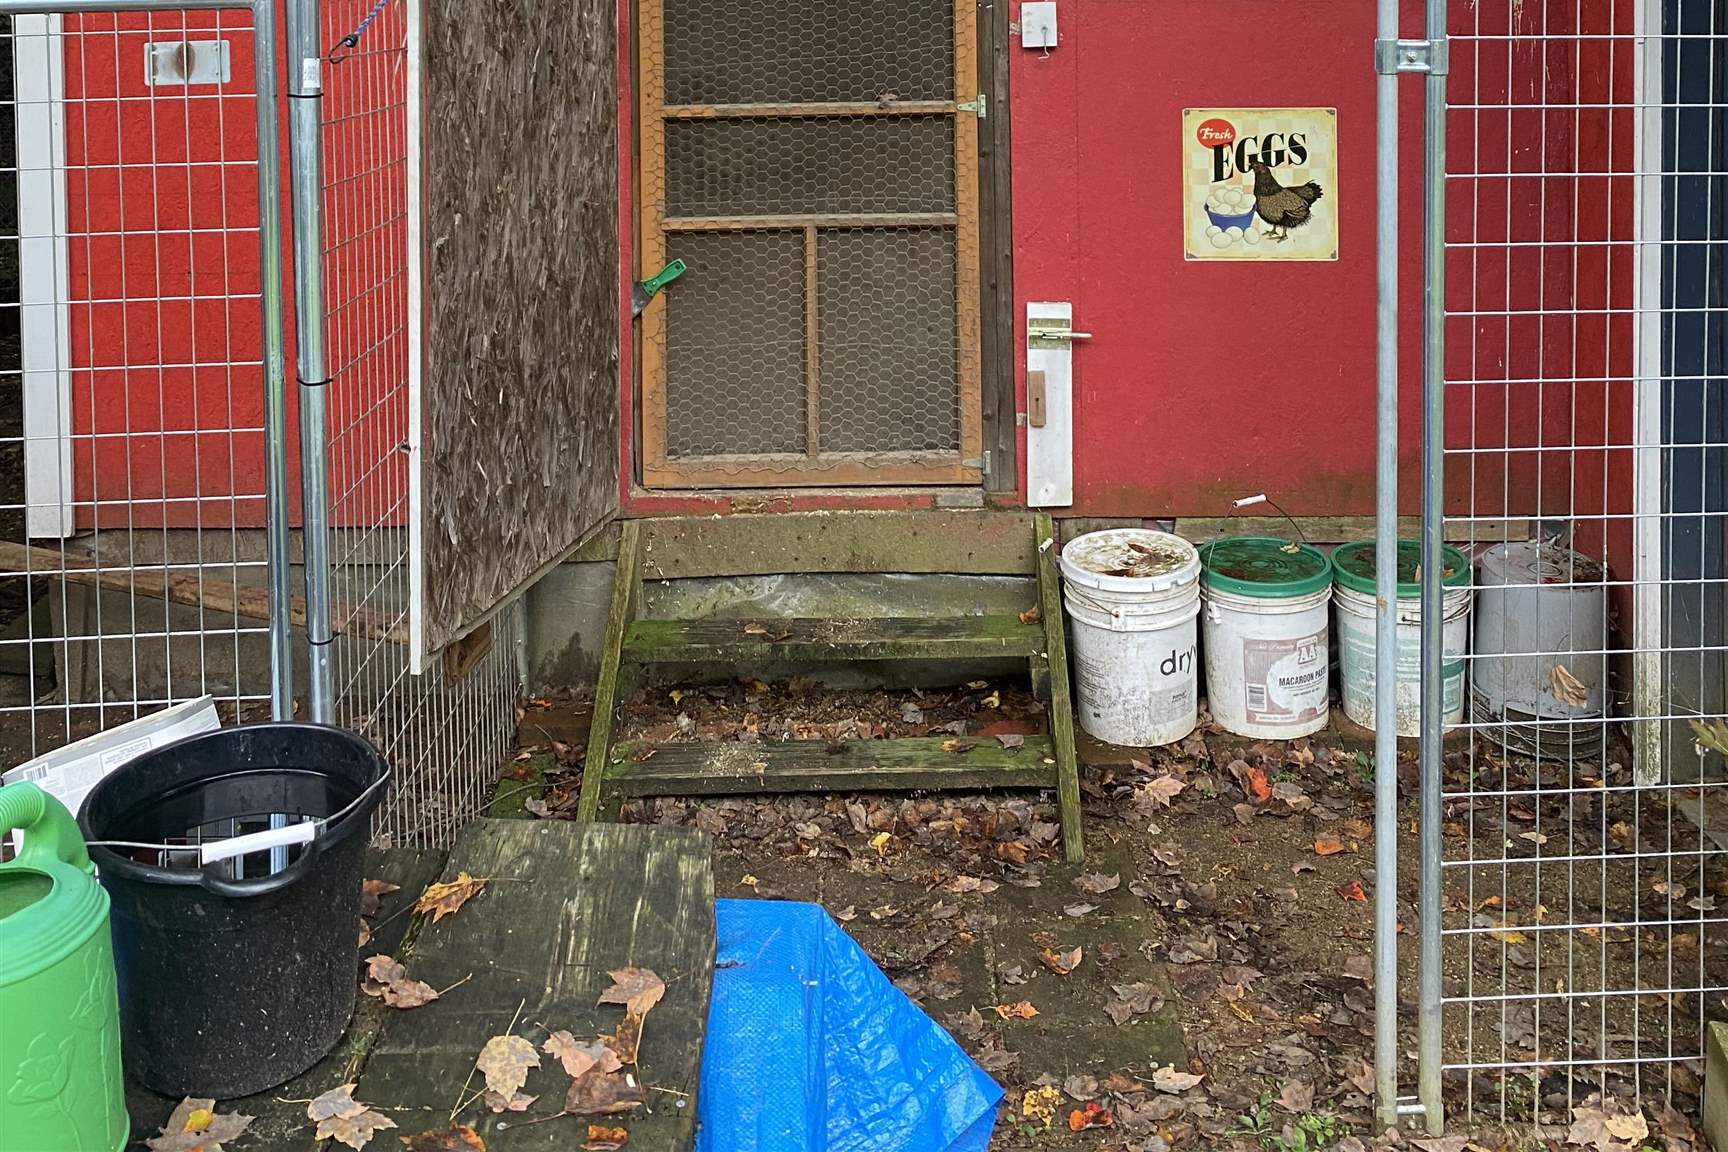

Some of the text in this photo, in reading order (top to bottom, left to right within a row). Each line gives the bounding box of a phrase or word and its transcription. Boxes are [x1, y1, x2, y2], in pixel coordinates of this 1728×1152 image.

[1199, 127, 1234, 140] Fresh
[1211, 132, 1308, 183] EGGS
[1278, 673, 1314, 687] MACAROON
